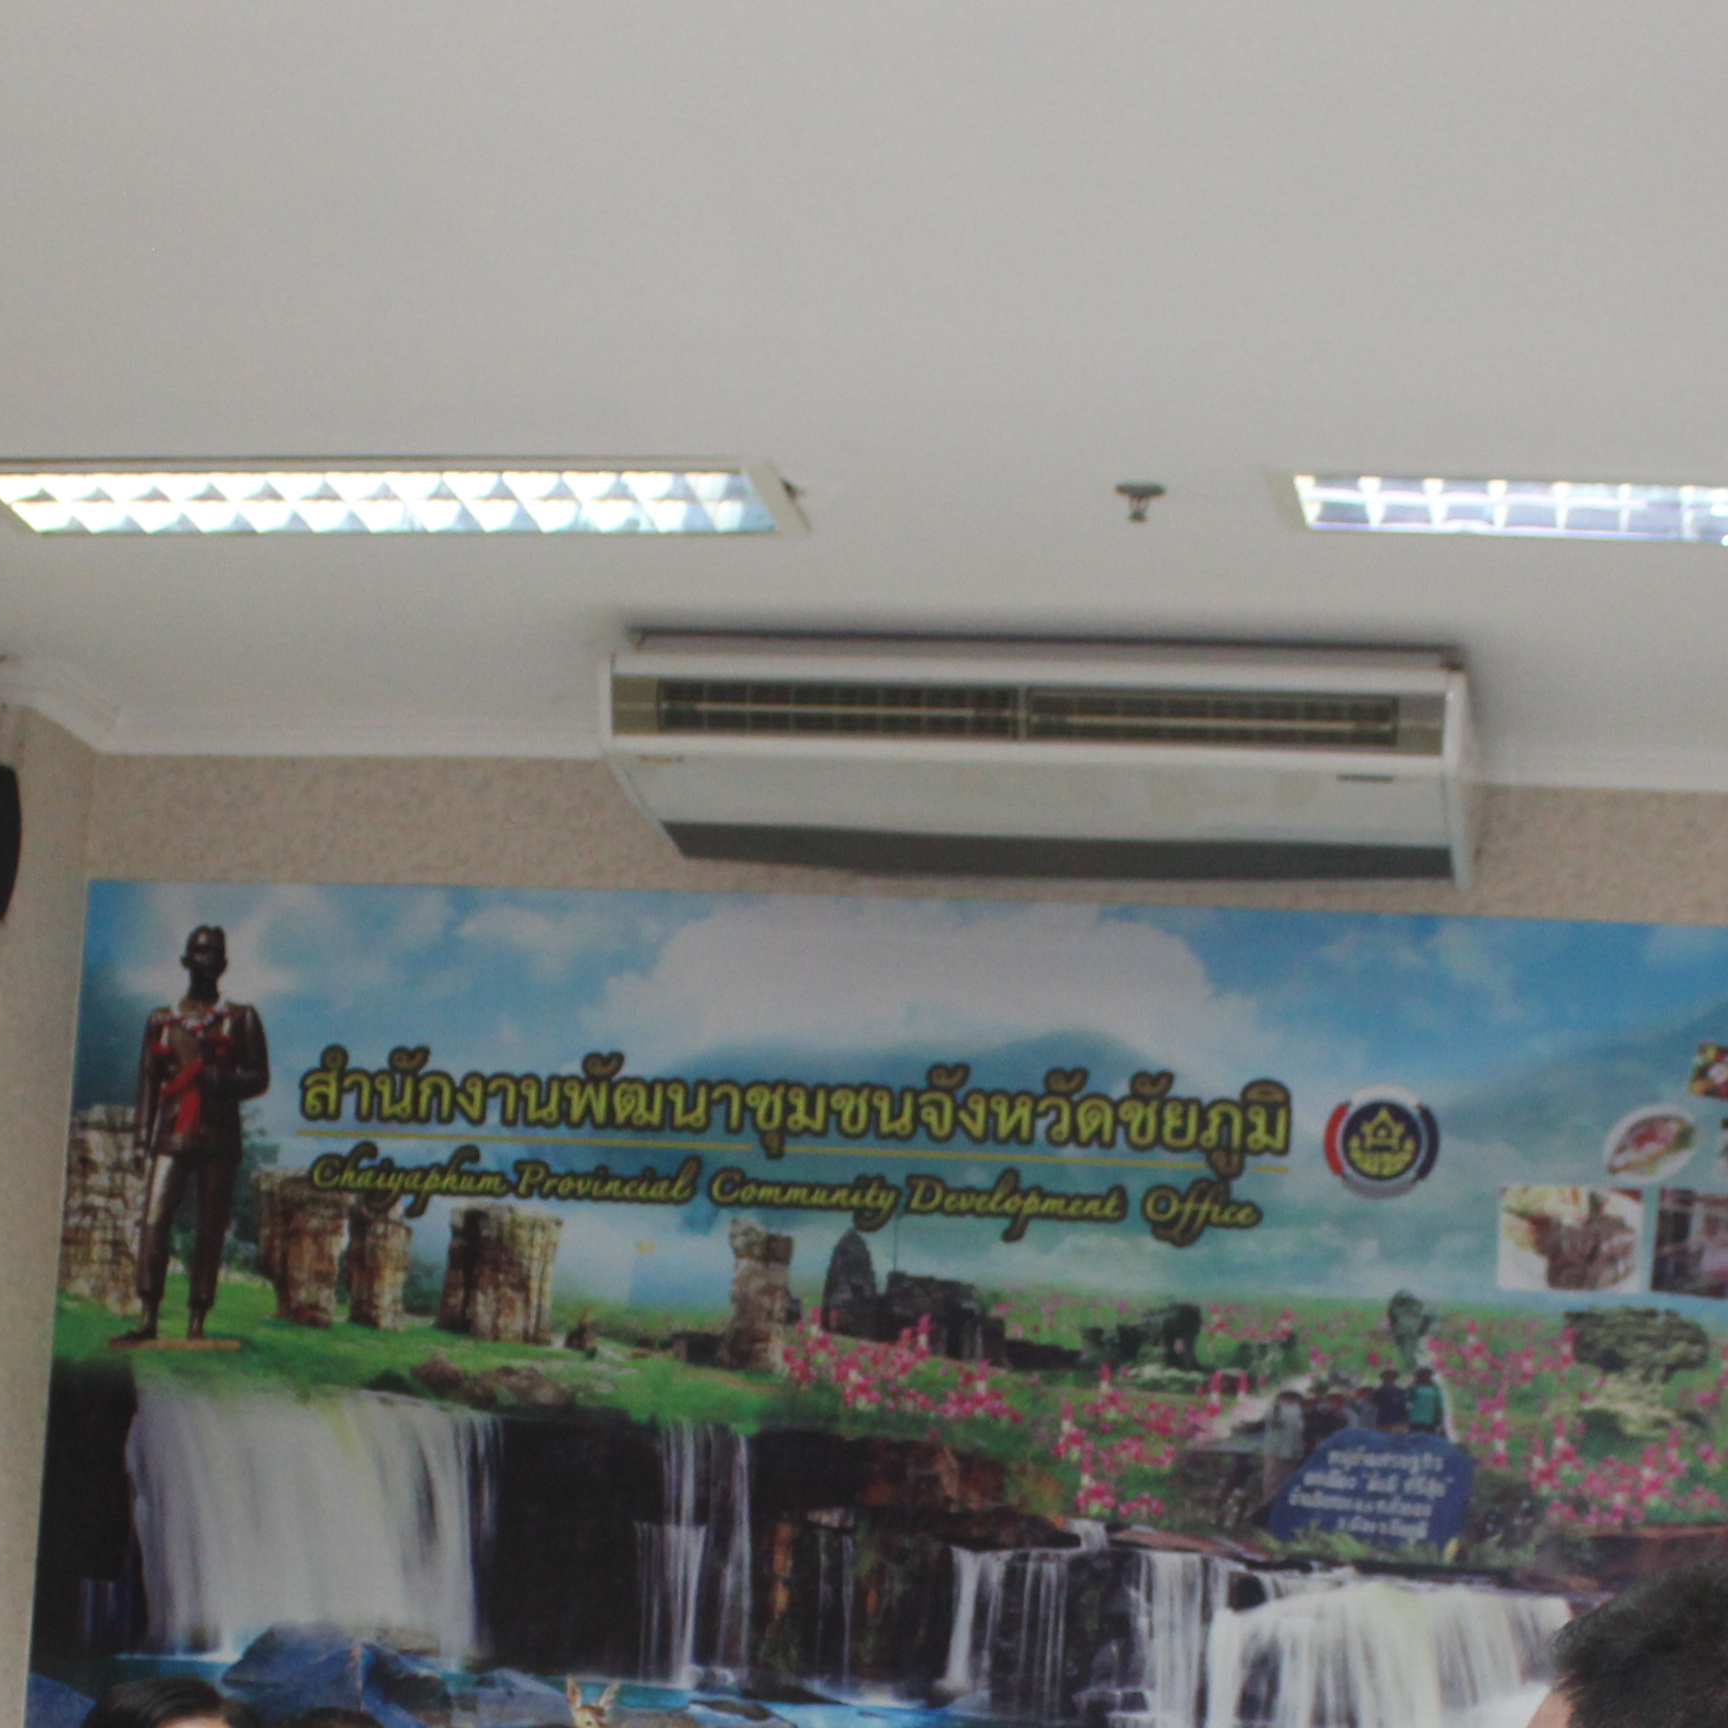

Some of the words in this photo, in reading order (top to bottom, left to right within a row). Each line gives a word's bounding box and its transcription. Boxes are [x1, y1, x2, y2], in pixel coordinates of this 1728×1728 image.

[299, 1043, 1291, 1180] สำนักงานพัฒนาชุมชนจังหวัดชัยภูมิ
[309, 1141, 509, 1218] Chaiyaphum
[510, 1155, 703, 1204] Provincial
[708, 1166, 903, 1233] Community
[903, 1166, 1128, 1243] Development
[1141, 1177, 1264, 1248] Office
